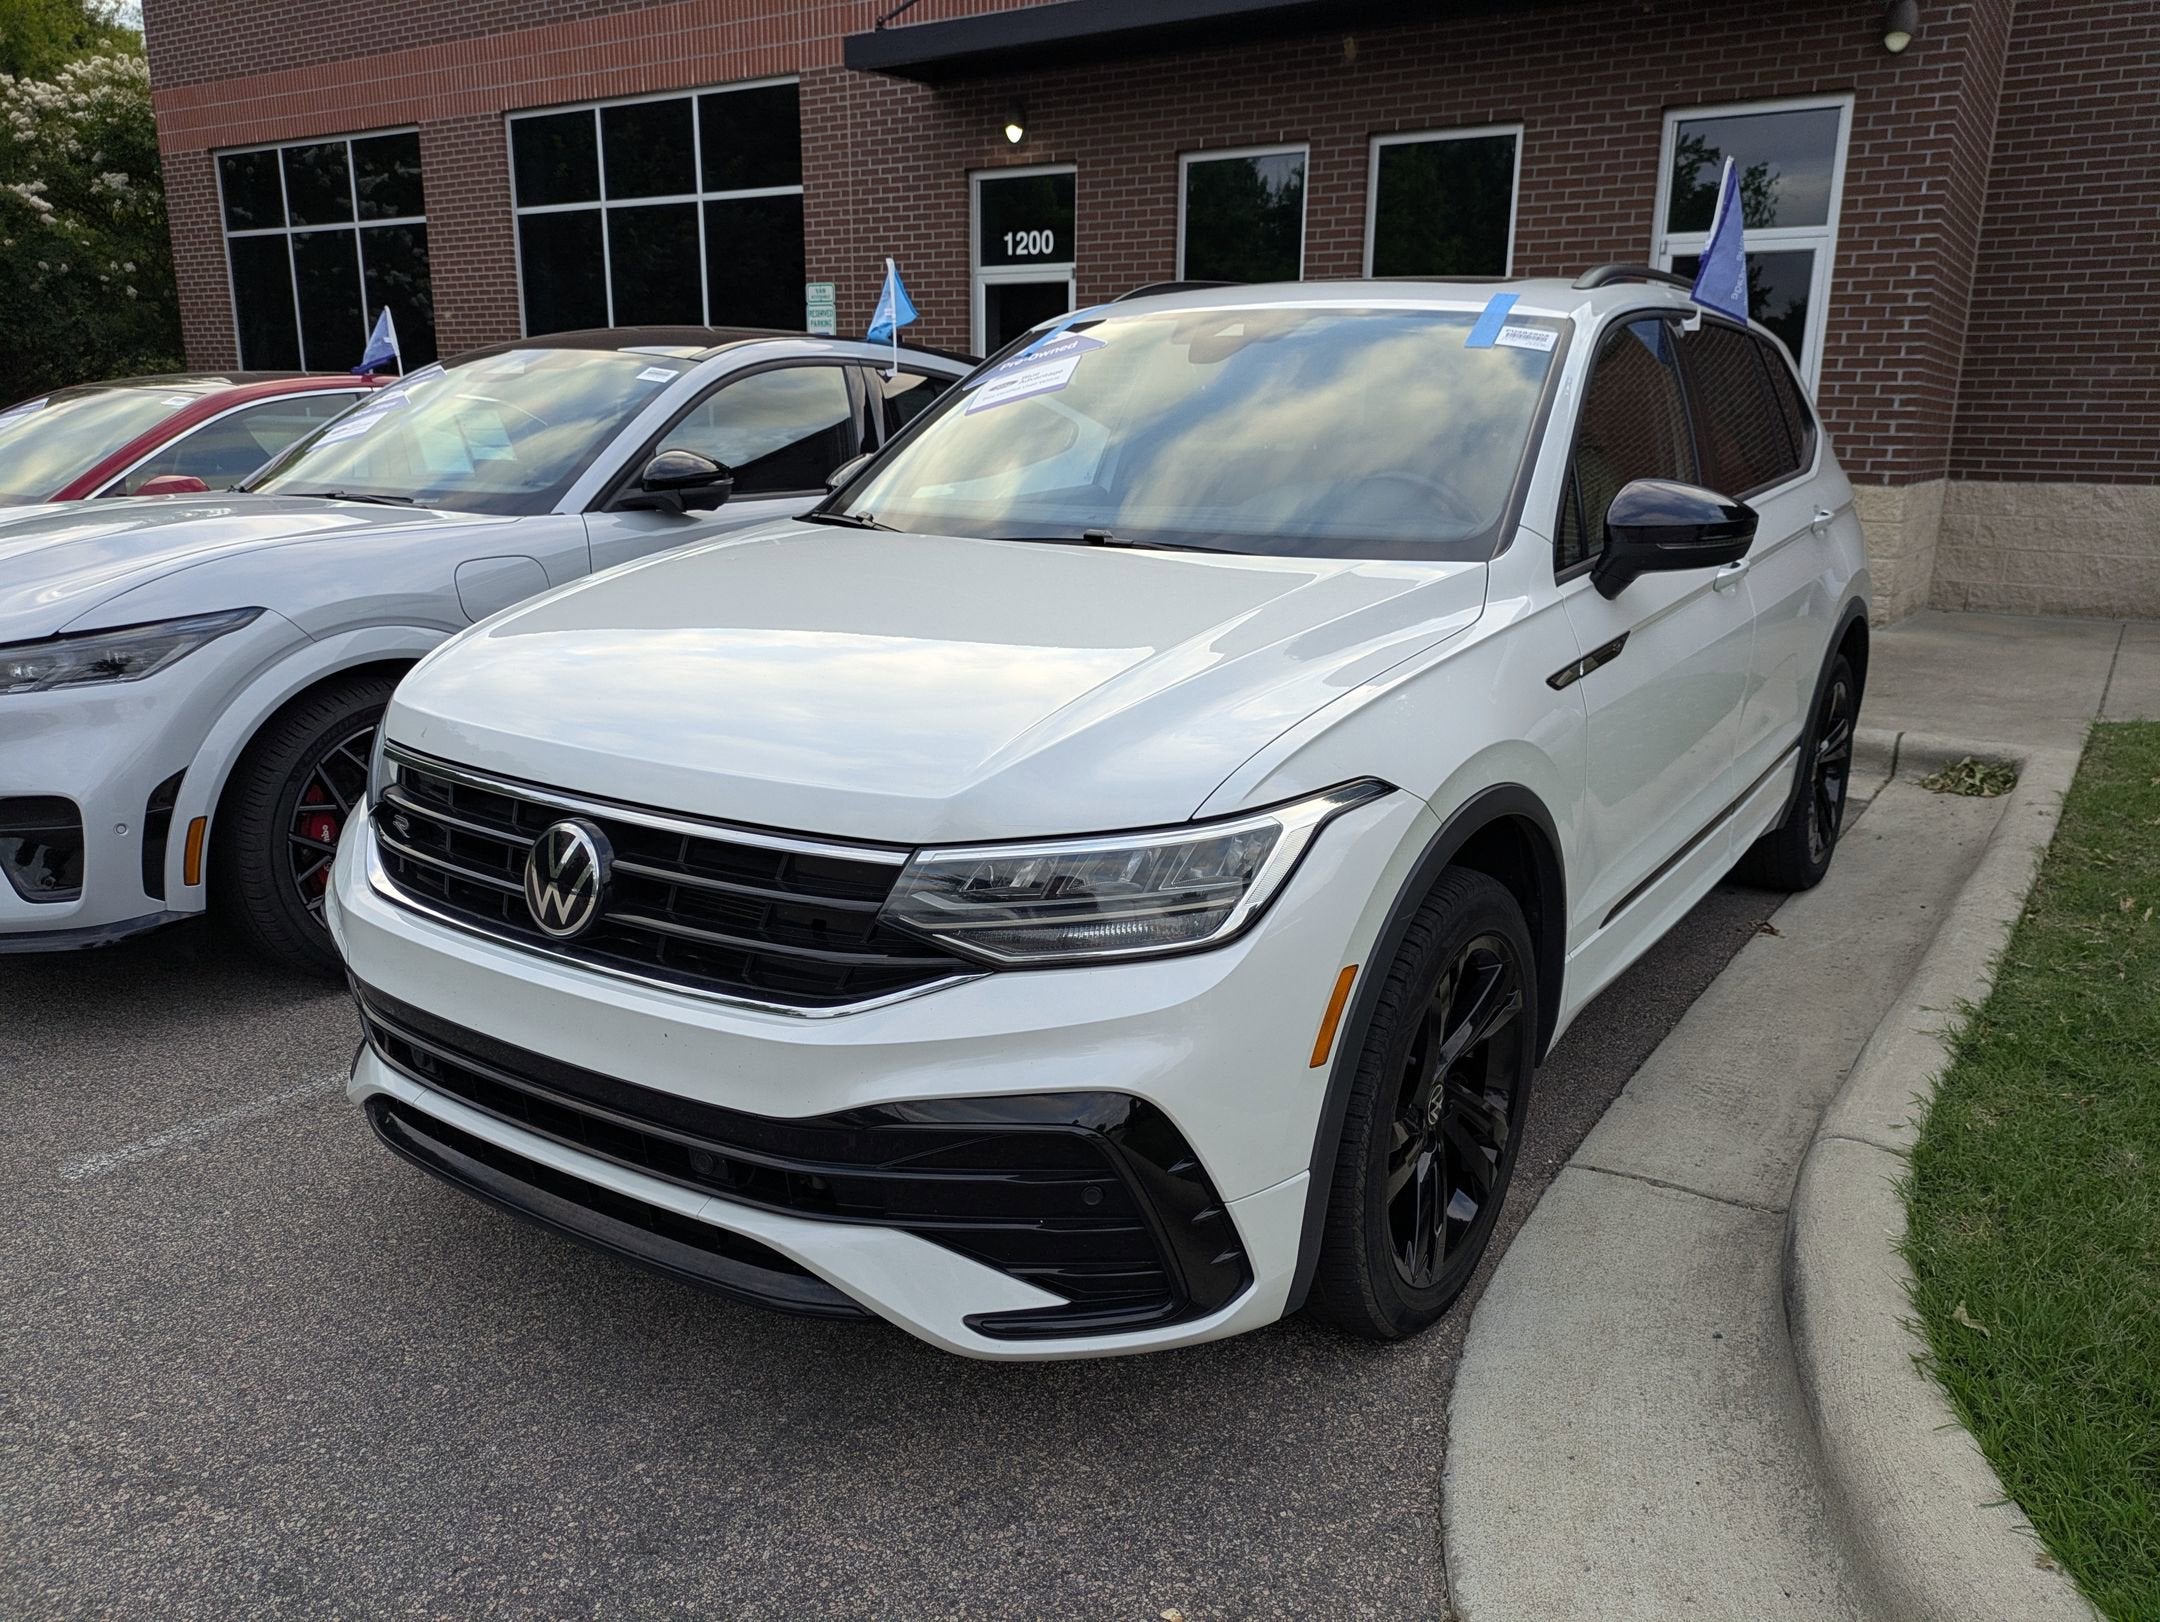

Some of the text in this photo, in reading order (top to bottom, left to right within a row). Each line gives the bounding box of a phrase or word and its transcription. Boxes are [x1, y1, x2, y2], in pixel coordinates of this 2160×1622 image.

[1003, 229, 1055, 256] 1200
[808, 310, 833, 318] RESERVED
[810, 319, 832, 327] PARKING
[1000, 341, 1079, 370] Pre-Owned
